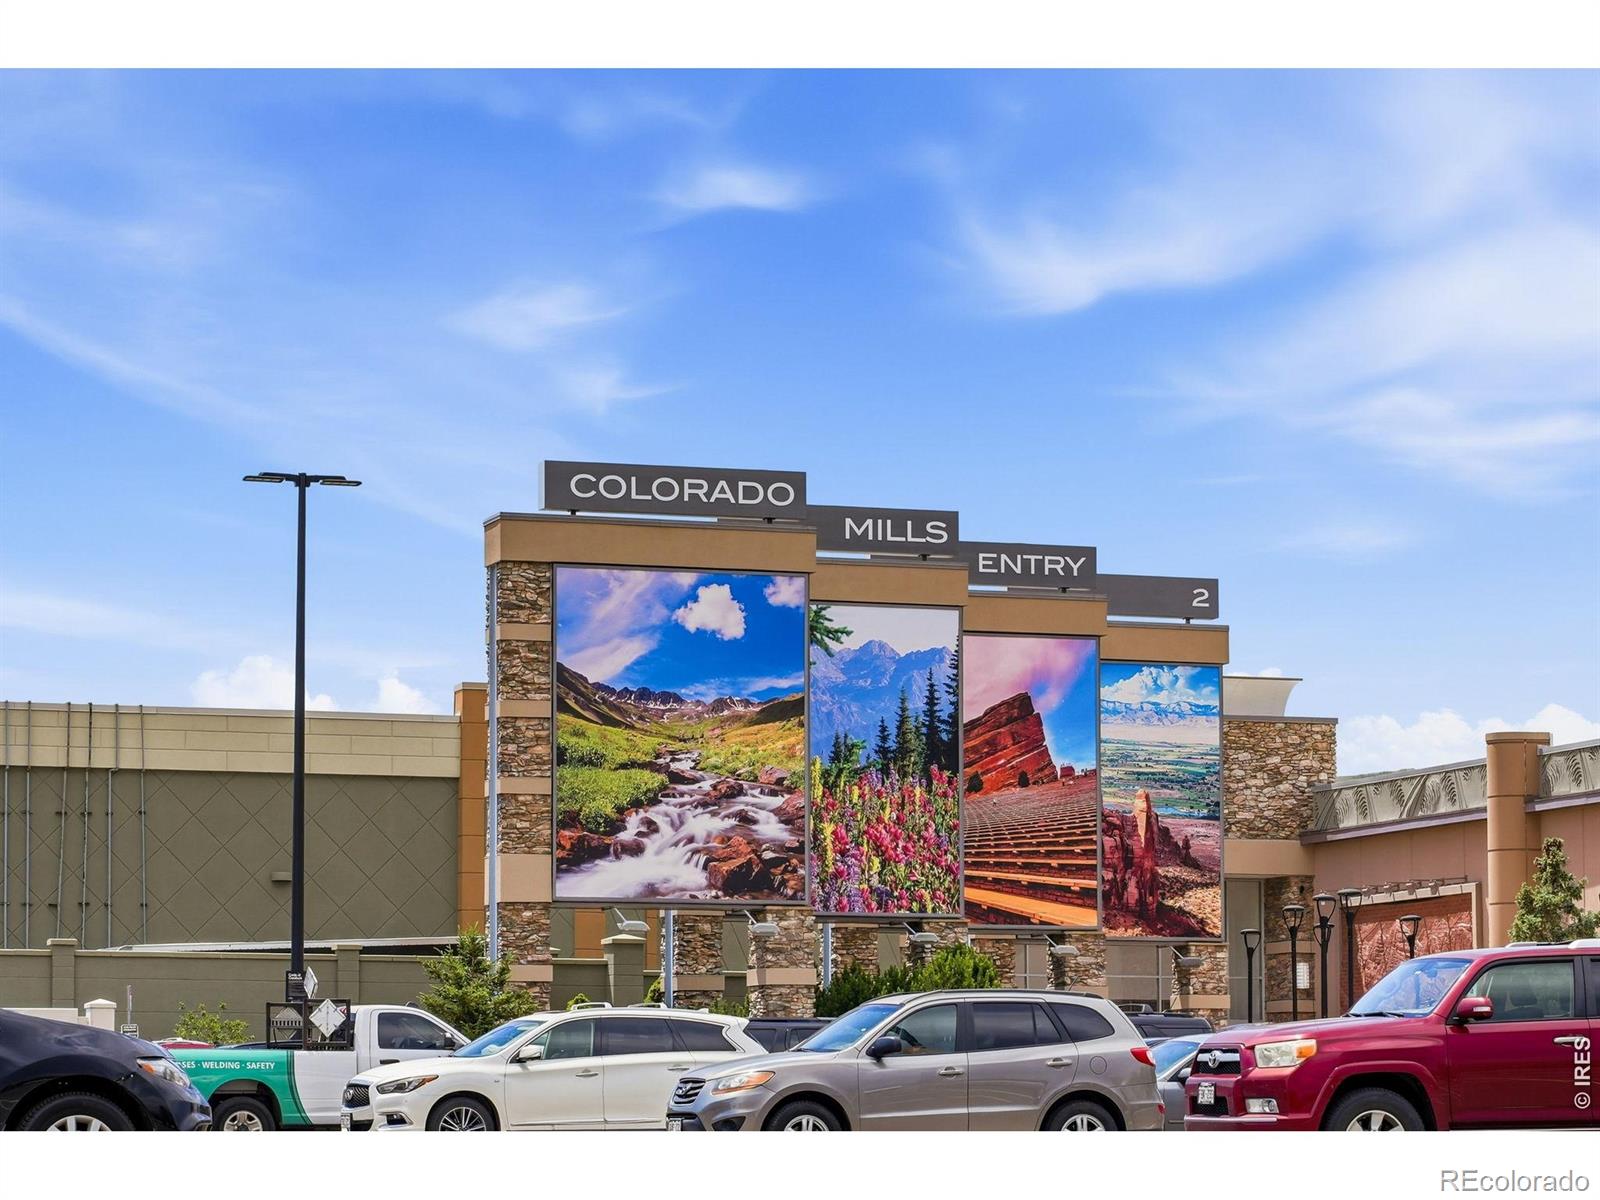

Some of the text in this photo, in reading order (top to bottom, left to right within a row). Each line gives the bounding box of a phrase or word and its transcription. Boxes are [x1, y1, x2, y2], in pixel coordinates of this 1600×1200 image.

[570, 473, 795, 507] COLORADO
[845, 517, 948, 544] MILLS
[978, 553, 1087, 577] ENTRY
[1192, 588, 1210, 608] 2
[201, 1061, 241, 1069] WELDING
[246, 1062, 275, 1070] SAFETY
